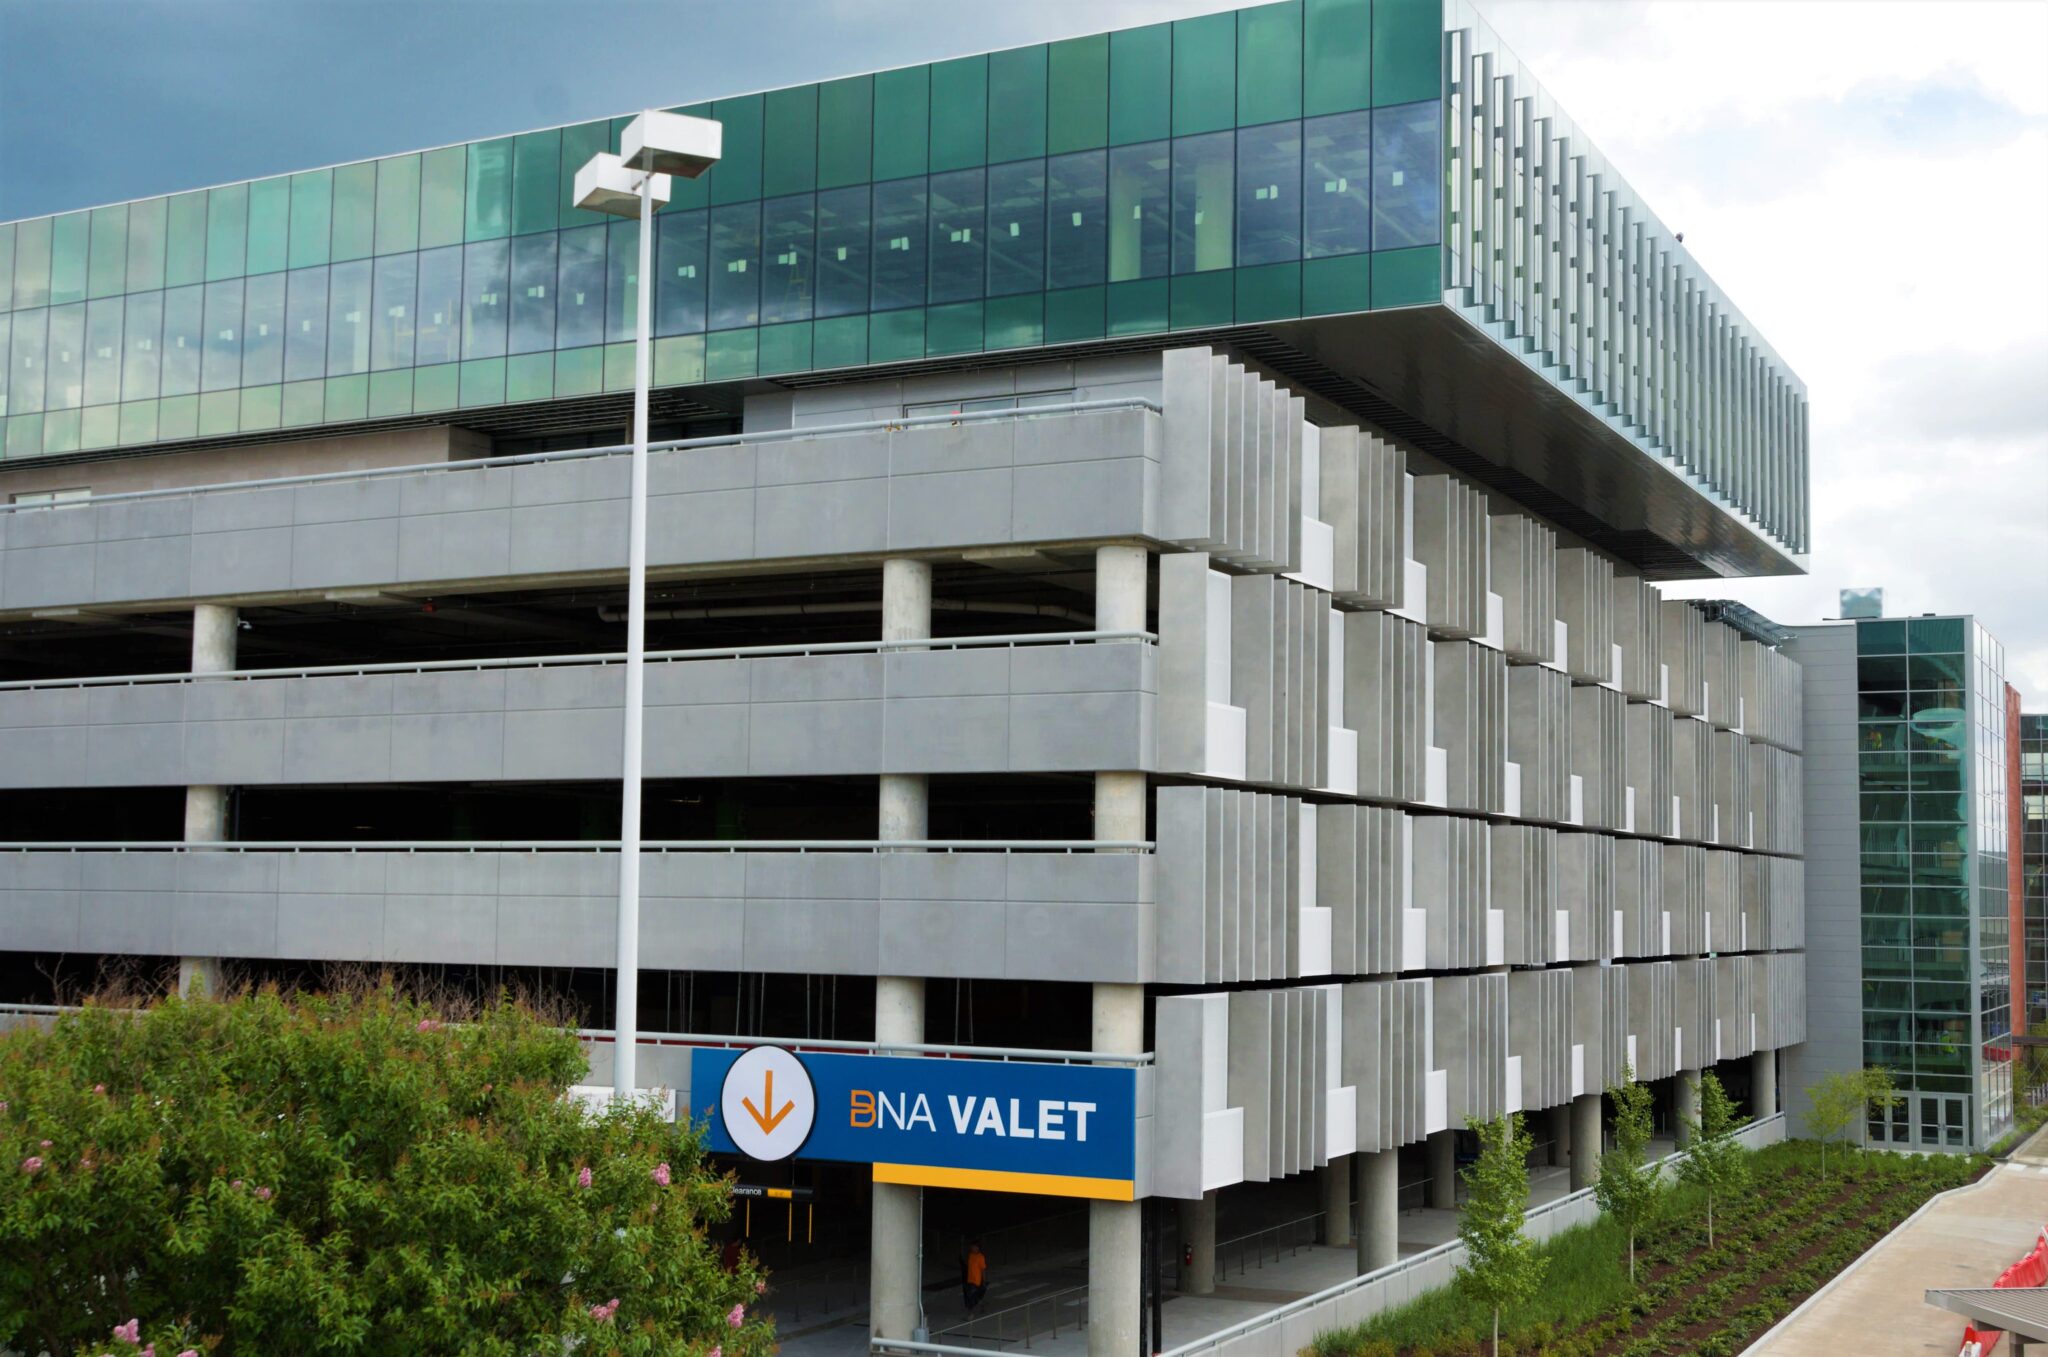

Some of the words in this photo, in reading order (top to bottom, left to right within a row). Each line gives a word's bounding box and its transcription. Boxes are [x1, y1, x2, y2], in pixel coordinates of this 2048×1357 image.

[850, 1089, 937, 1132] BNA
[947, 1095, 1097, 1142] VALET
[731, 1186, 762, 1196] learance
